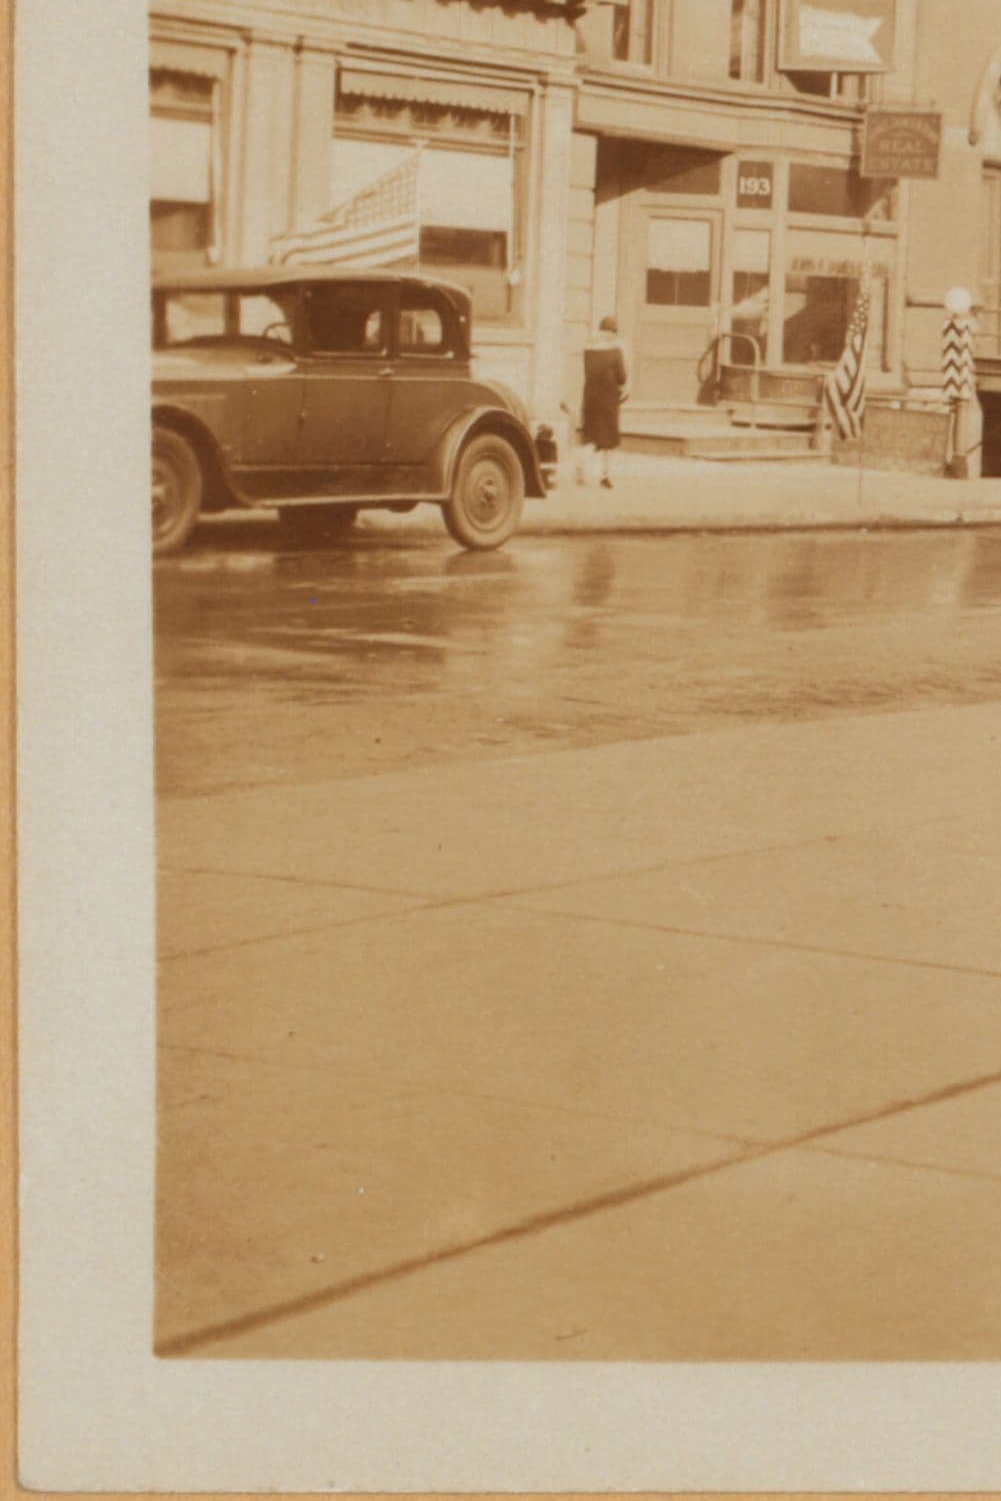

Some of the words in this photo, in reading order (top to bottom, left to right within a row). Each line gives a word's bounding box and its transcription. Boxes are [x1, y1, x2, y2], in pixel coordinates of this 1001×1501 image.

[879, 139, 926, 154] REAL
[868, 157, 934, 172] ESTATE
[739, 177, 770, 196] 193
